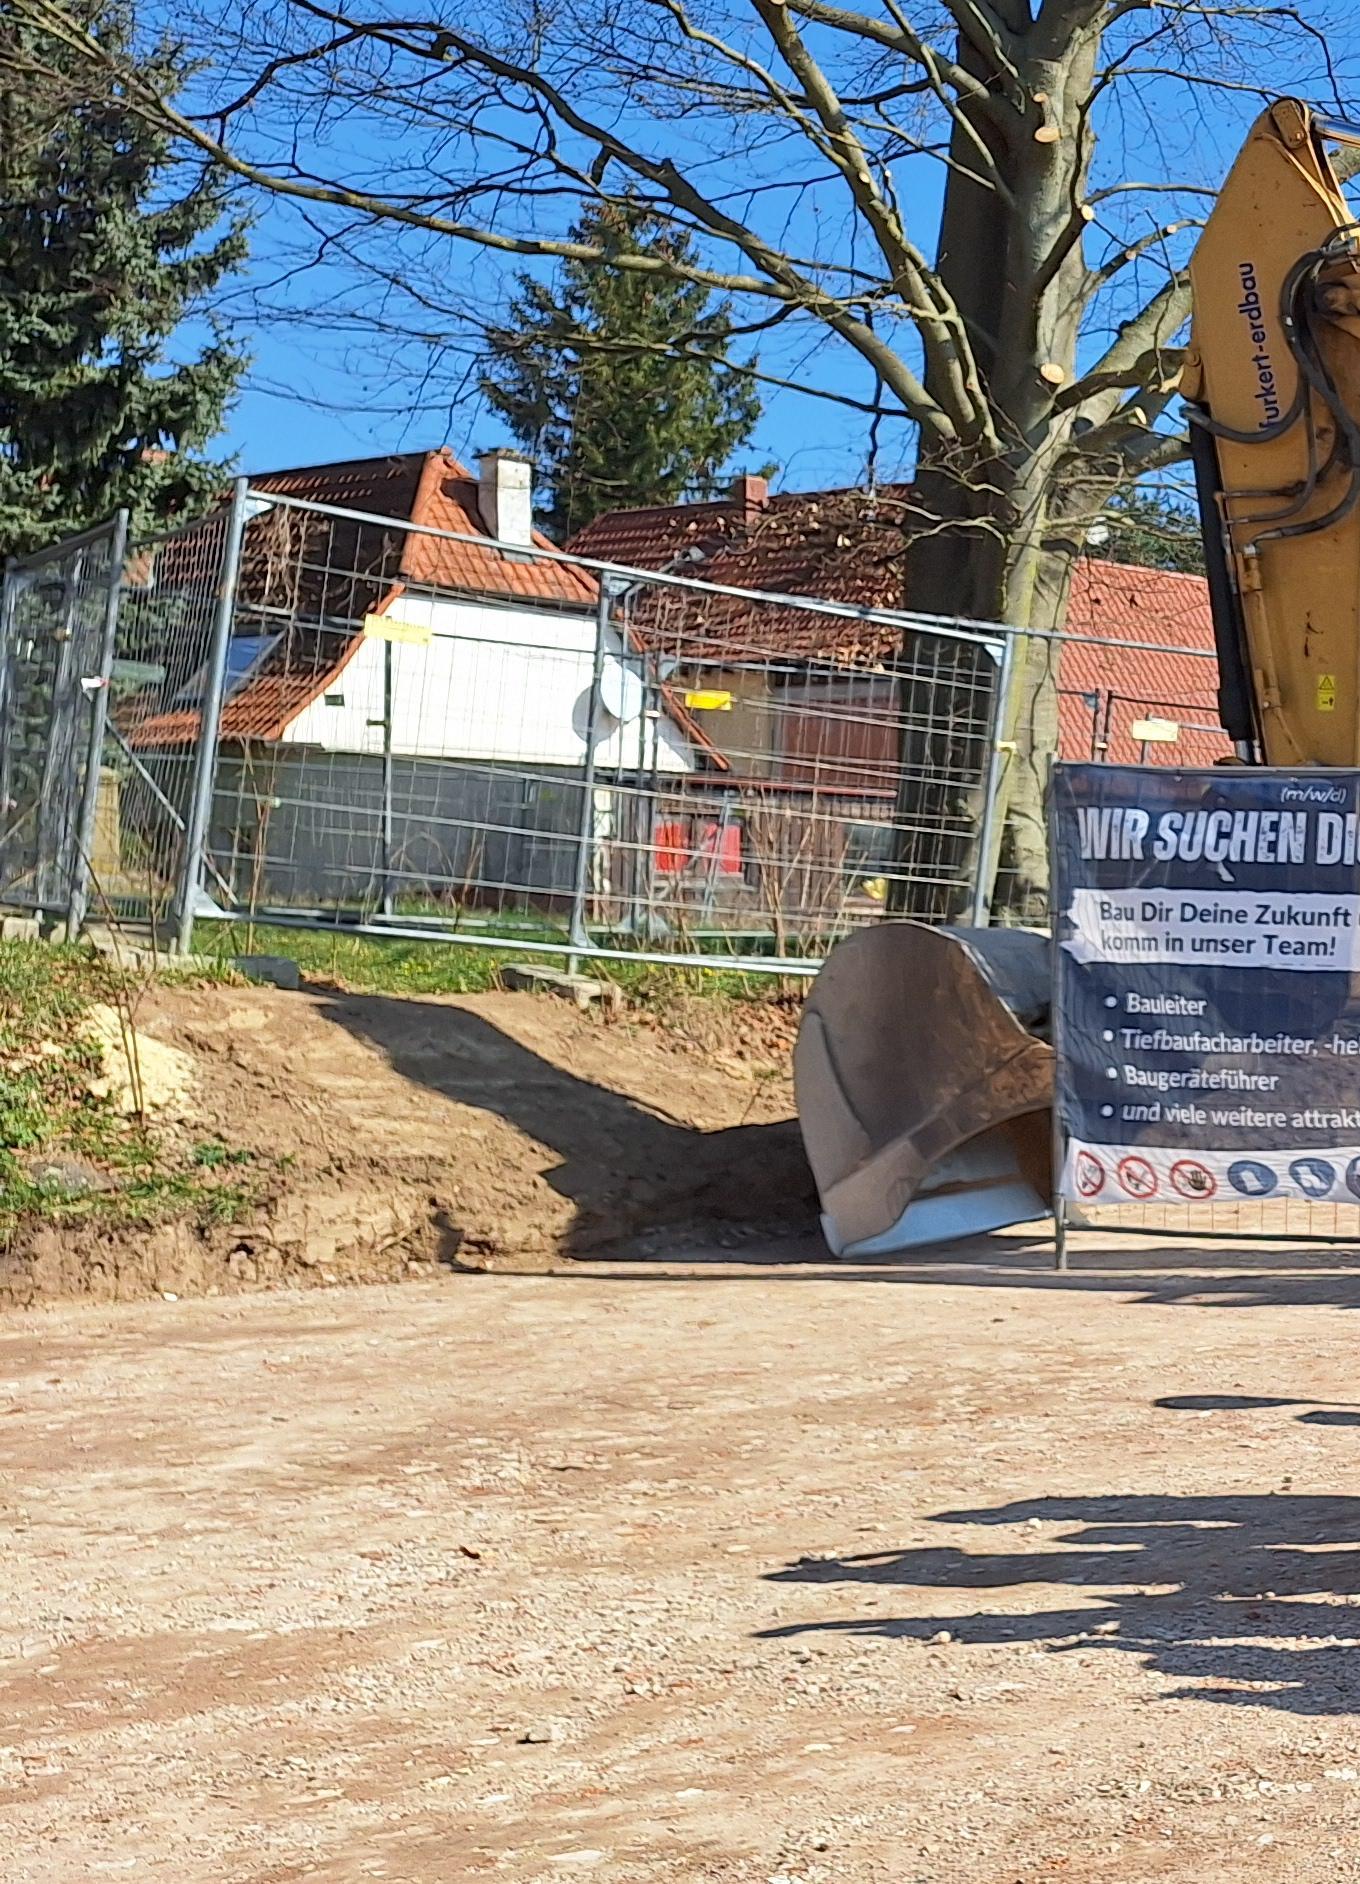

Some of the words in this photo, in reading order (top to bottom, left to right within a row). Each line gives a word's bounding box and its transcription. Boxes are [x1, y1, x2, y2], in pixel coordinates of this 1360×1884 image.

[1238, 262, 1280, 430] furkert-erdbau
[1280, 787, 1346, 804] (m/w/d)
[1077, 806, 1149, 862] WIR
[1153, 809, 1306, 865] SUCHEN
[1099, 901, 1135, 922] Bau
[1141, 902, 1173, 924] Dir
[1179, 902, 1248, 926] Deine
[1254, 904, 1352, 928] Zukunft
[1100, 930, 1159, 953] komm
[1165, 932, 1184, 953] in
[1191, 938, 1256, 955] unser
[1262, 934, 1336, 957] Team!
[1126, 992, 1208, 1016] Bauleiter
[1121, 1028, 1319, 1057] Tiefbaufacharbeiter,
[1124, 1065, 1280, 1092] Baugeräteführer
[1122, 1101, 1161, 1123] und
[1165, 1103, 1207, 1126] viele
[1210, 1105, 1287, 1128] weitere
